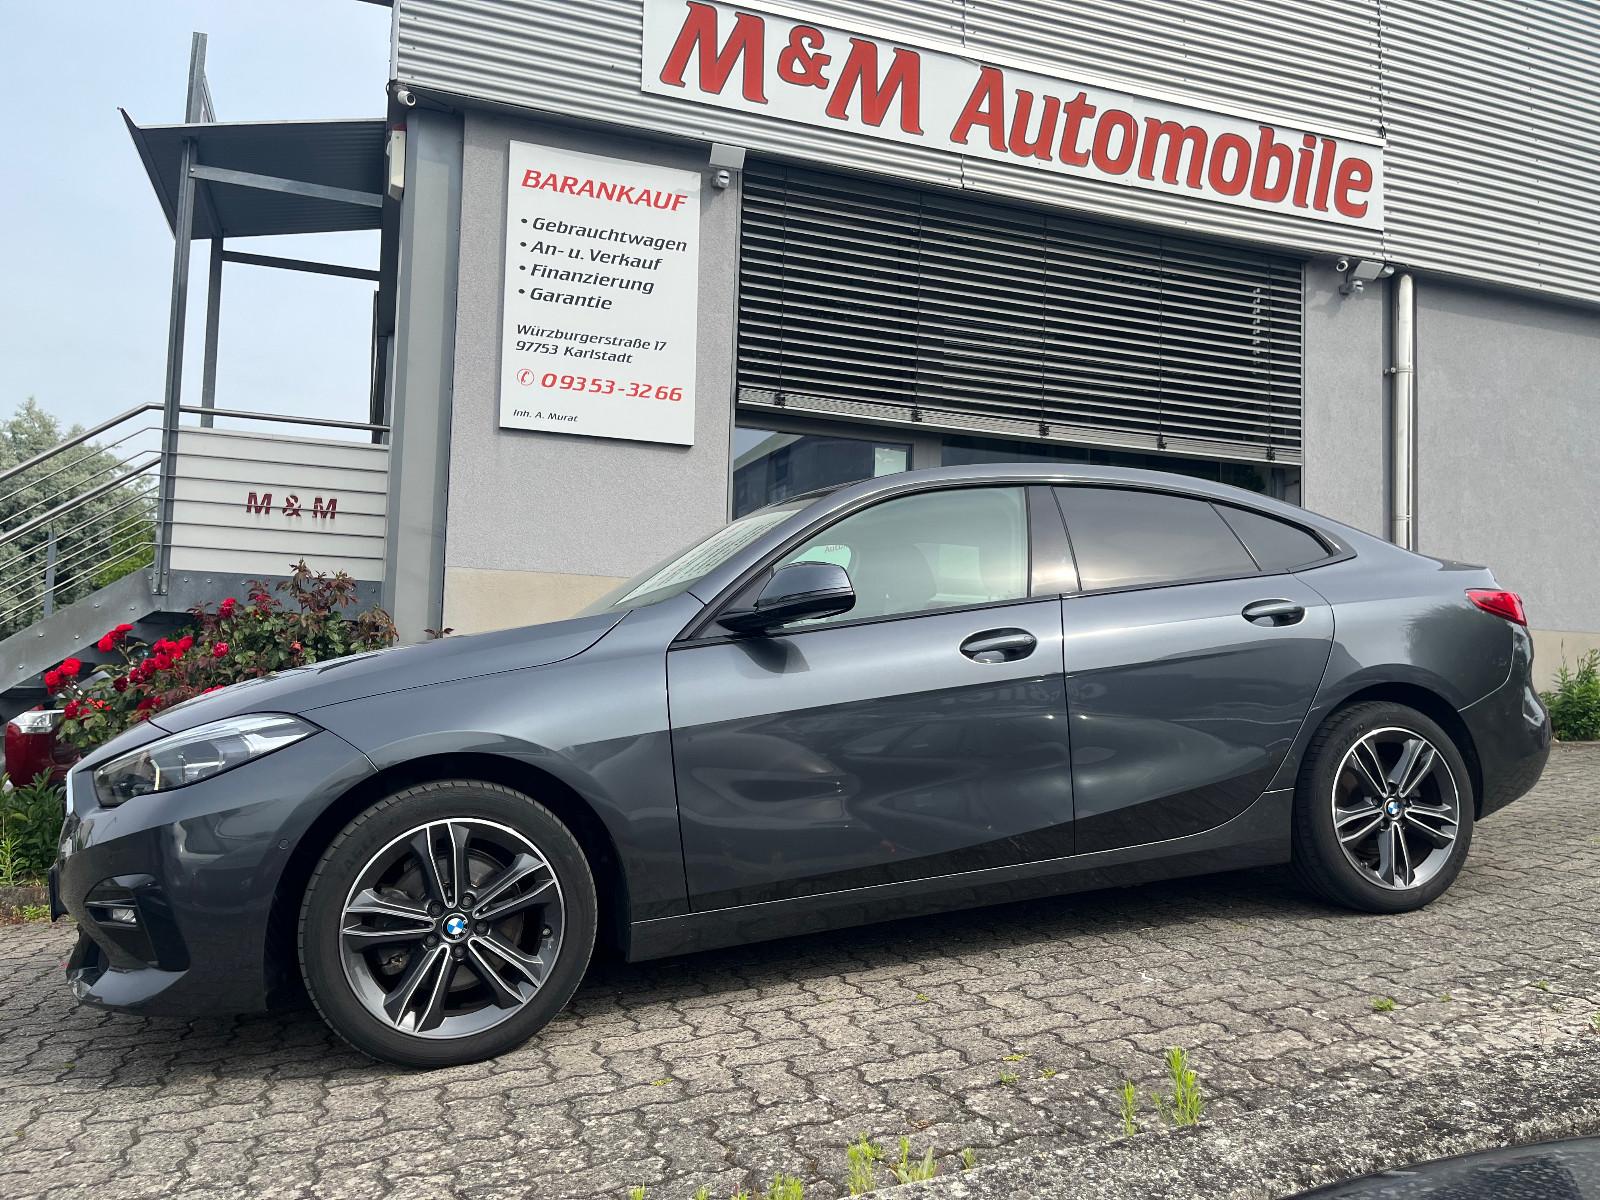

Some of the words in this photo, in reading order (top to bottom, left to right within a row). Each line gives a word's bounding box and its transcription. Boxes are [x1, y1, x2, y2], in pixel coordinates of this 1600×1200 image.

[659, 1, 924, 136] M&M
[949, 65, 1374, 219] Automobile
[520, 168, 689, 212] BARANKAUF
[532, 217, 688, 252] Gebrauchtwagen
[530, 240, 564, 256] An-
[568, 247, 585, 260] u.
[590, 248, 663, 271] Verkauf
[530, 263, 655, 295] Finanzierung
[529, 287, 613, 310] Garantie
[515, 340, 559, 355] 97753
[563, 346, 633, 364] Karlstadt
[516, 323, 651, 350] Würzburgerstraße
[654, 340, 668, 351] 17
[513, 408, 532, 419] Inh.
[534, 411, 545, 420] A.
[547, 412, 579, 423] Murat
